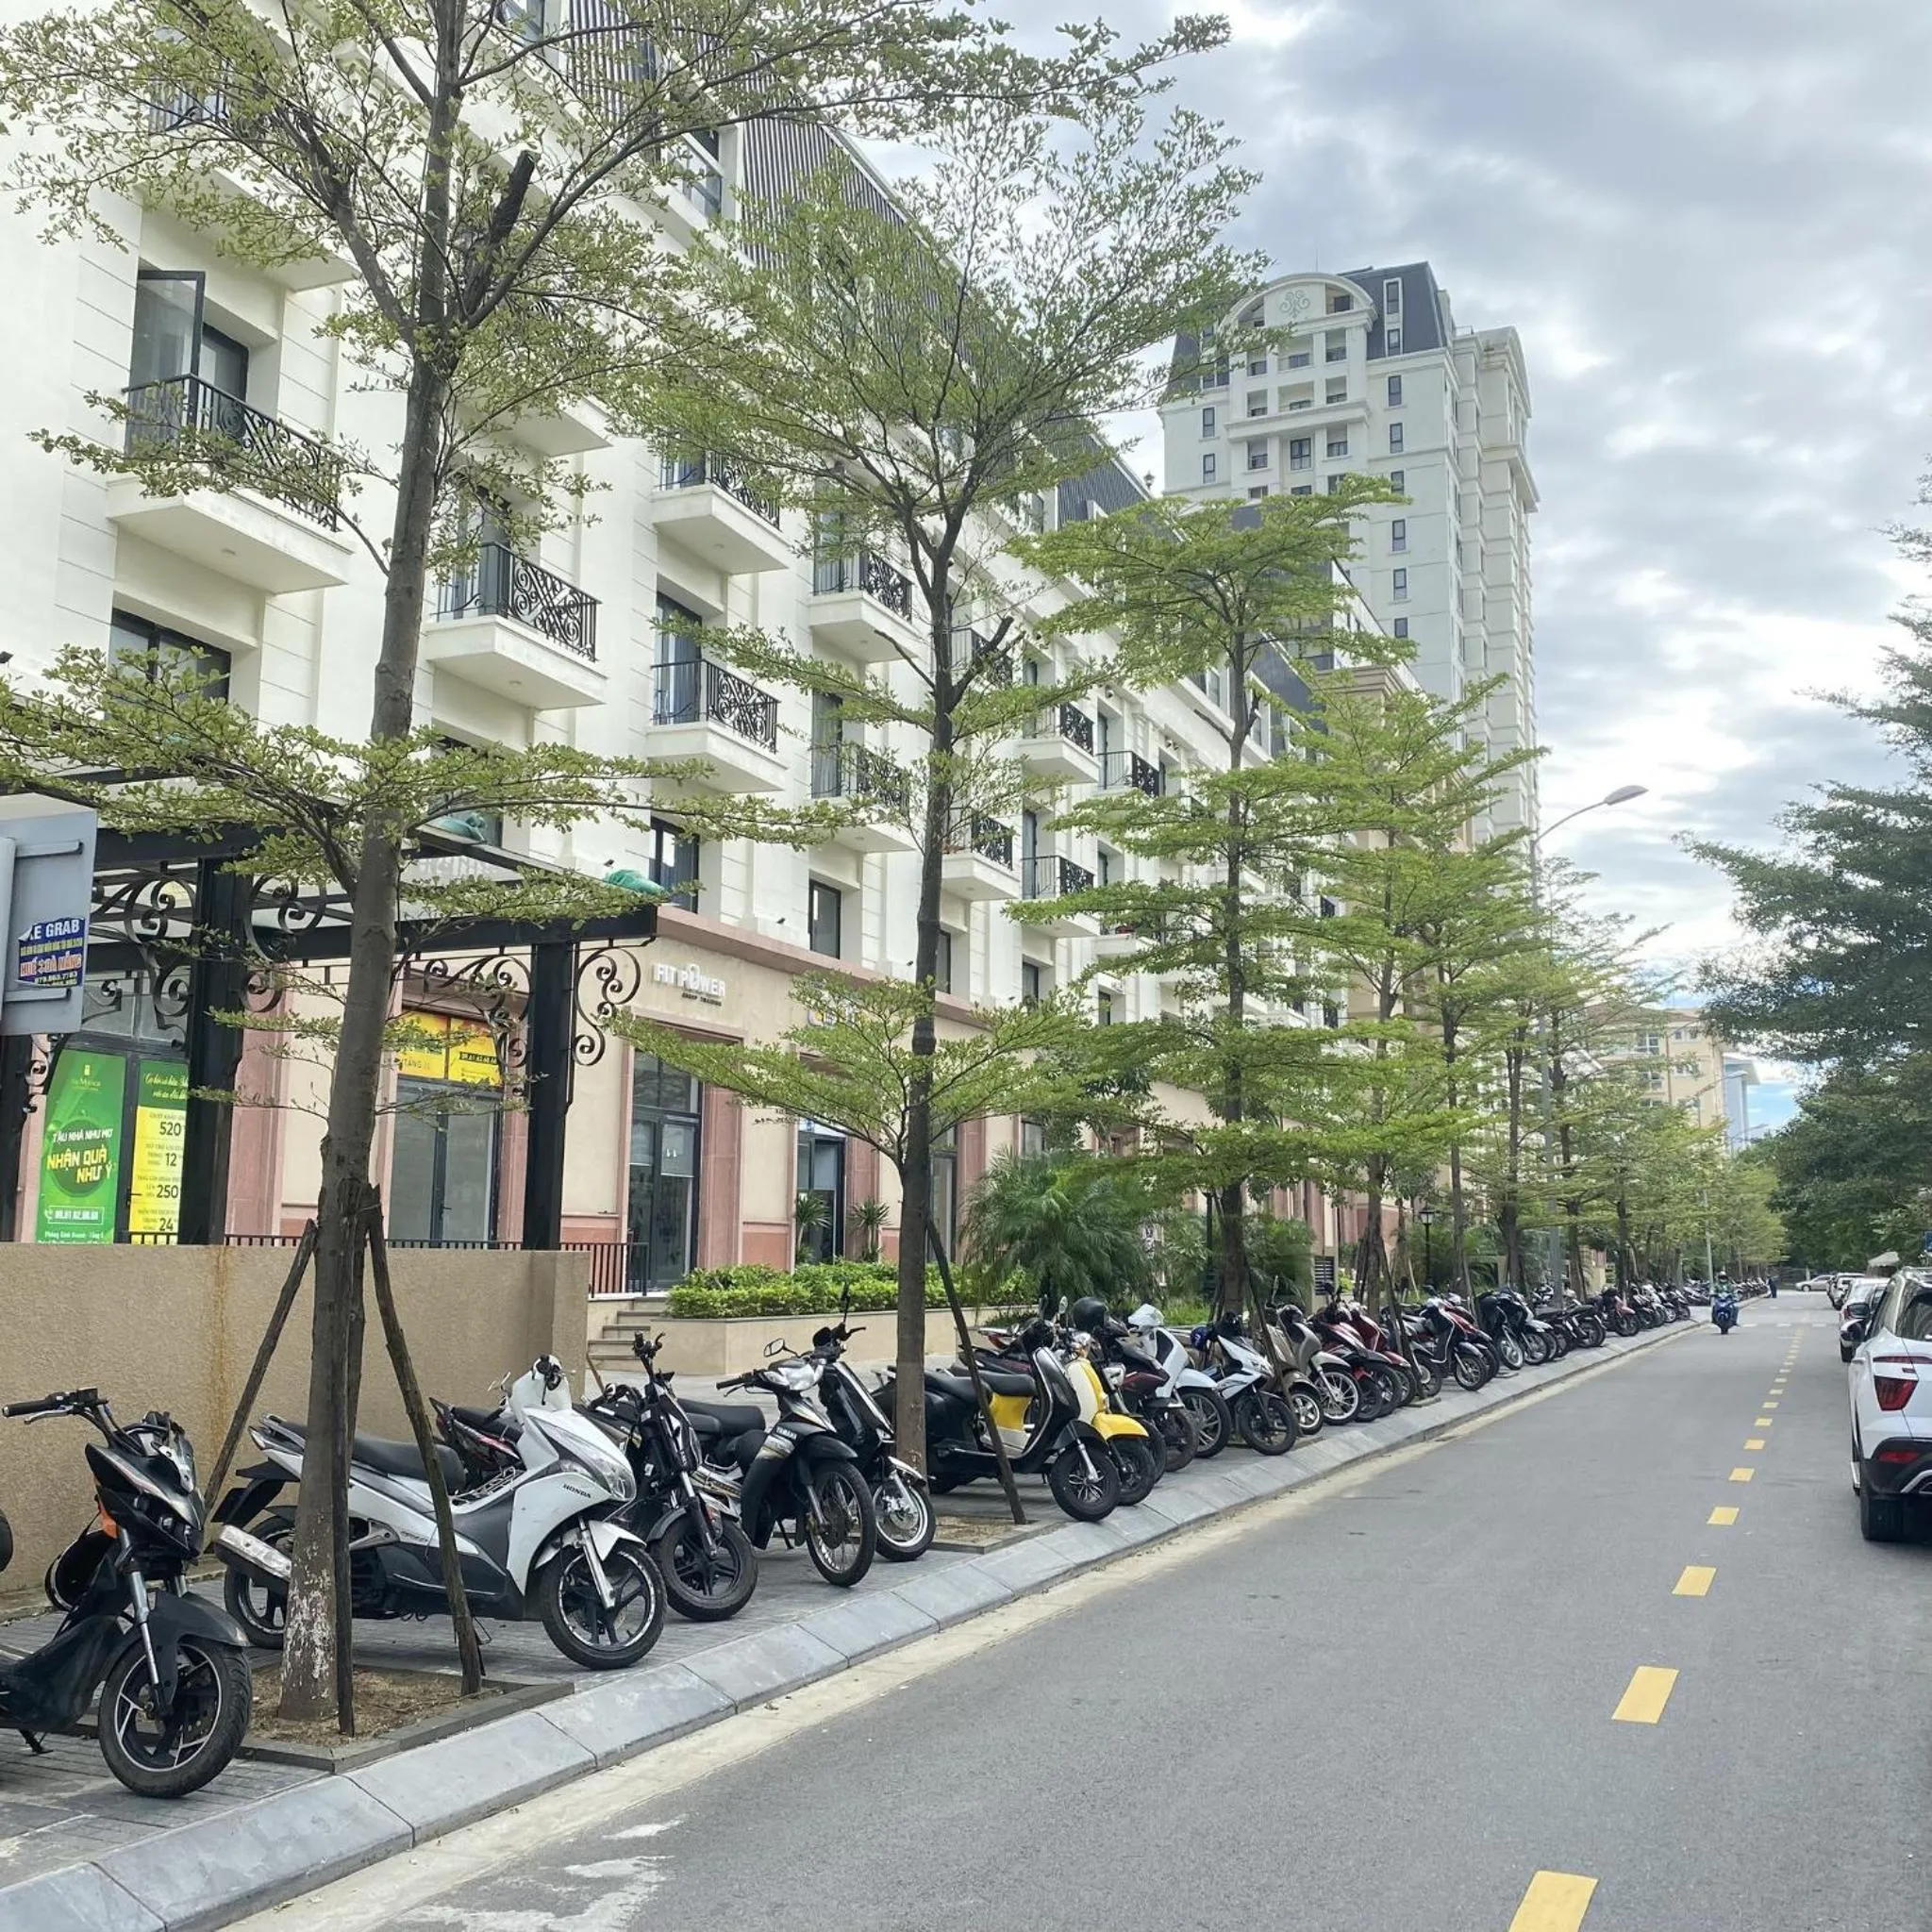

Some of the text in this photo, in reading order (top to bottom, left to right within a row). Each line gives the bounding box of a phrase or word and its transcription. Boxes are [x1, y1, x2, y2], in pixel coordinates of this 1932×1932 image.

[30, 919, 80, 941] E GRAB
[654, 962, 676, 984] FIT
[159, 1122, 181, 1137] 520
[47, 1148, 80, 1171] NHẬN
[165, 1153, 177, 1167] 12
[76, 1165, 103, 1184] NHƯ
[157, 1185, 178, 1199] 250
[159, 1218, 174, 1231] 24
[562, 1483, 591, 1499] HONDA
